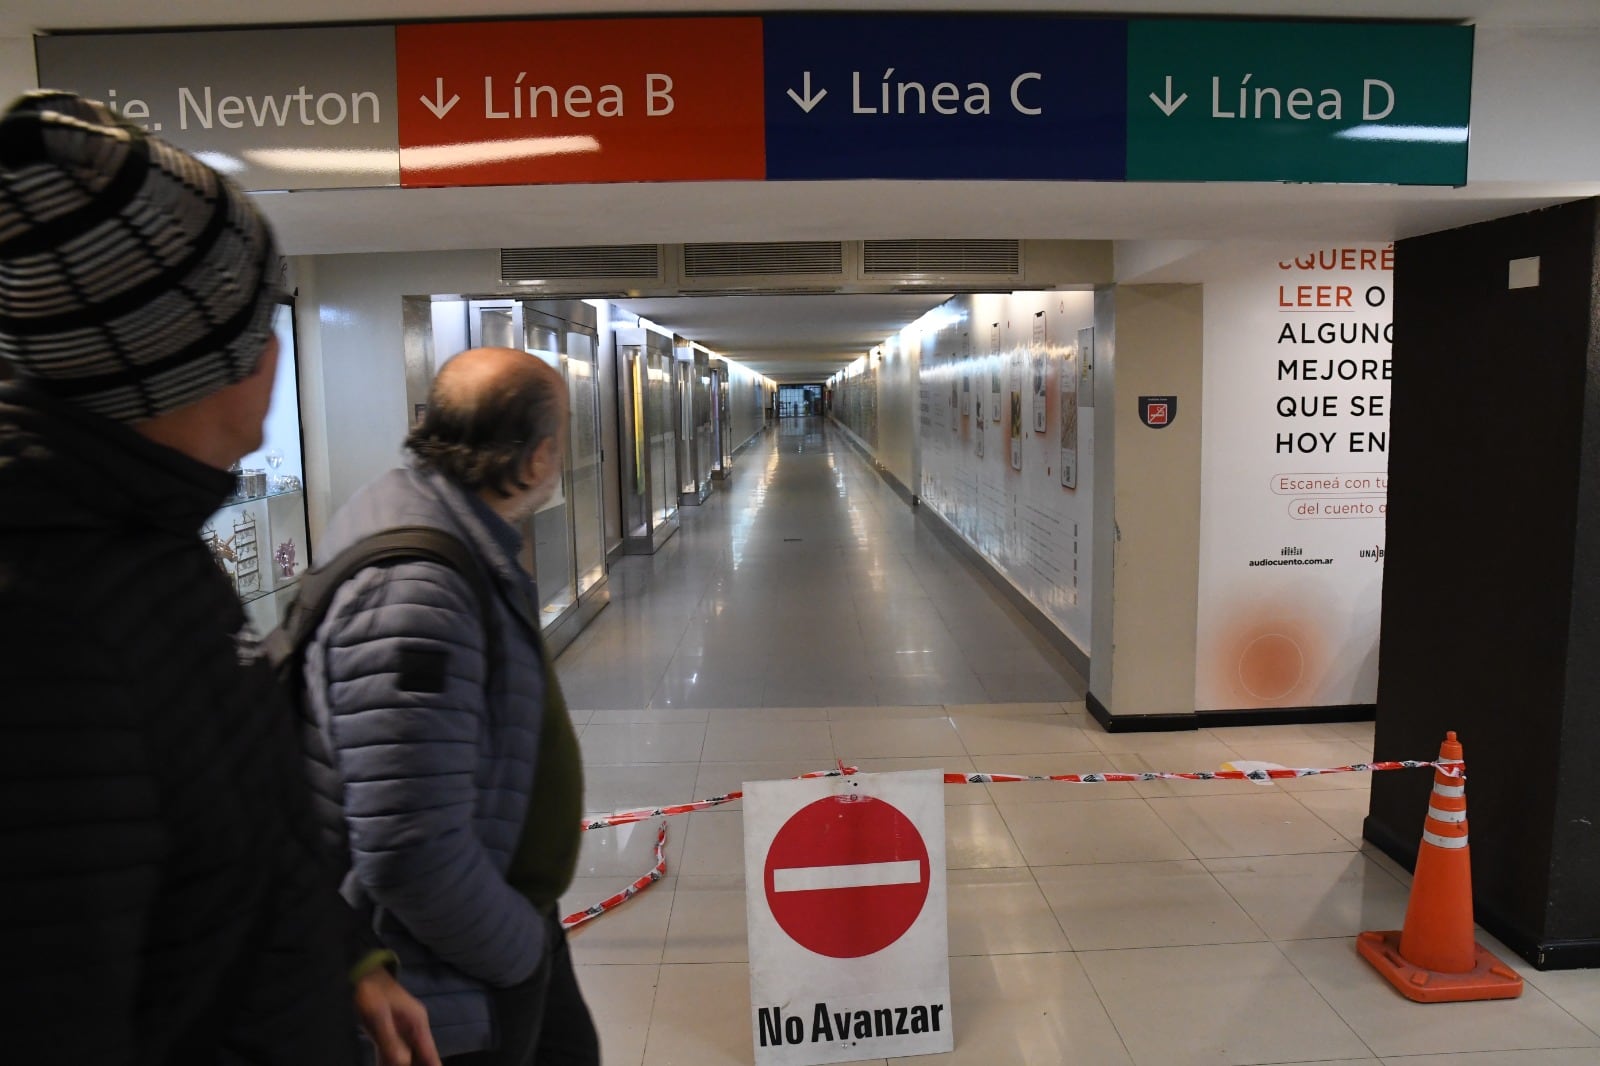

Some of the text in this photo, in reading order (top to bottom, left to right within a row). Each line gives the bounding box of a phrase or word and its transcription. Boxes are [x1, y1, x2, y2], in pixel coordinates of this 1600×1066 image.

[484, 71, 675, 119] Línea B
[852, 67, 1042, 115] Línea C
[1212, 73, 1395, 121] Línea D
[178, 86, 380, 130] Newton
[1279, 285, 1386, 308] LEER O
[1277, 359, 1392, 381] MEJORE
[1276, 395, 1385, 418] QUE SE
[1275, 431, 1386, 454] HOY EN
[1279, 476, 1340, 490] Escaneá
[1344, 479, 1371, 489] con
[1297, 502, 1319, 515] del
[1324, 502, 1374, 514] cuento
[1248, 557, 1334, 567] audiocuento.com.ar
[758, 1002, 944, 1048] No Avanzar
